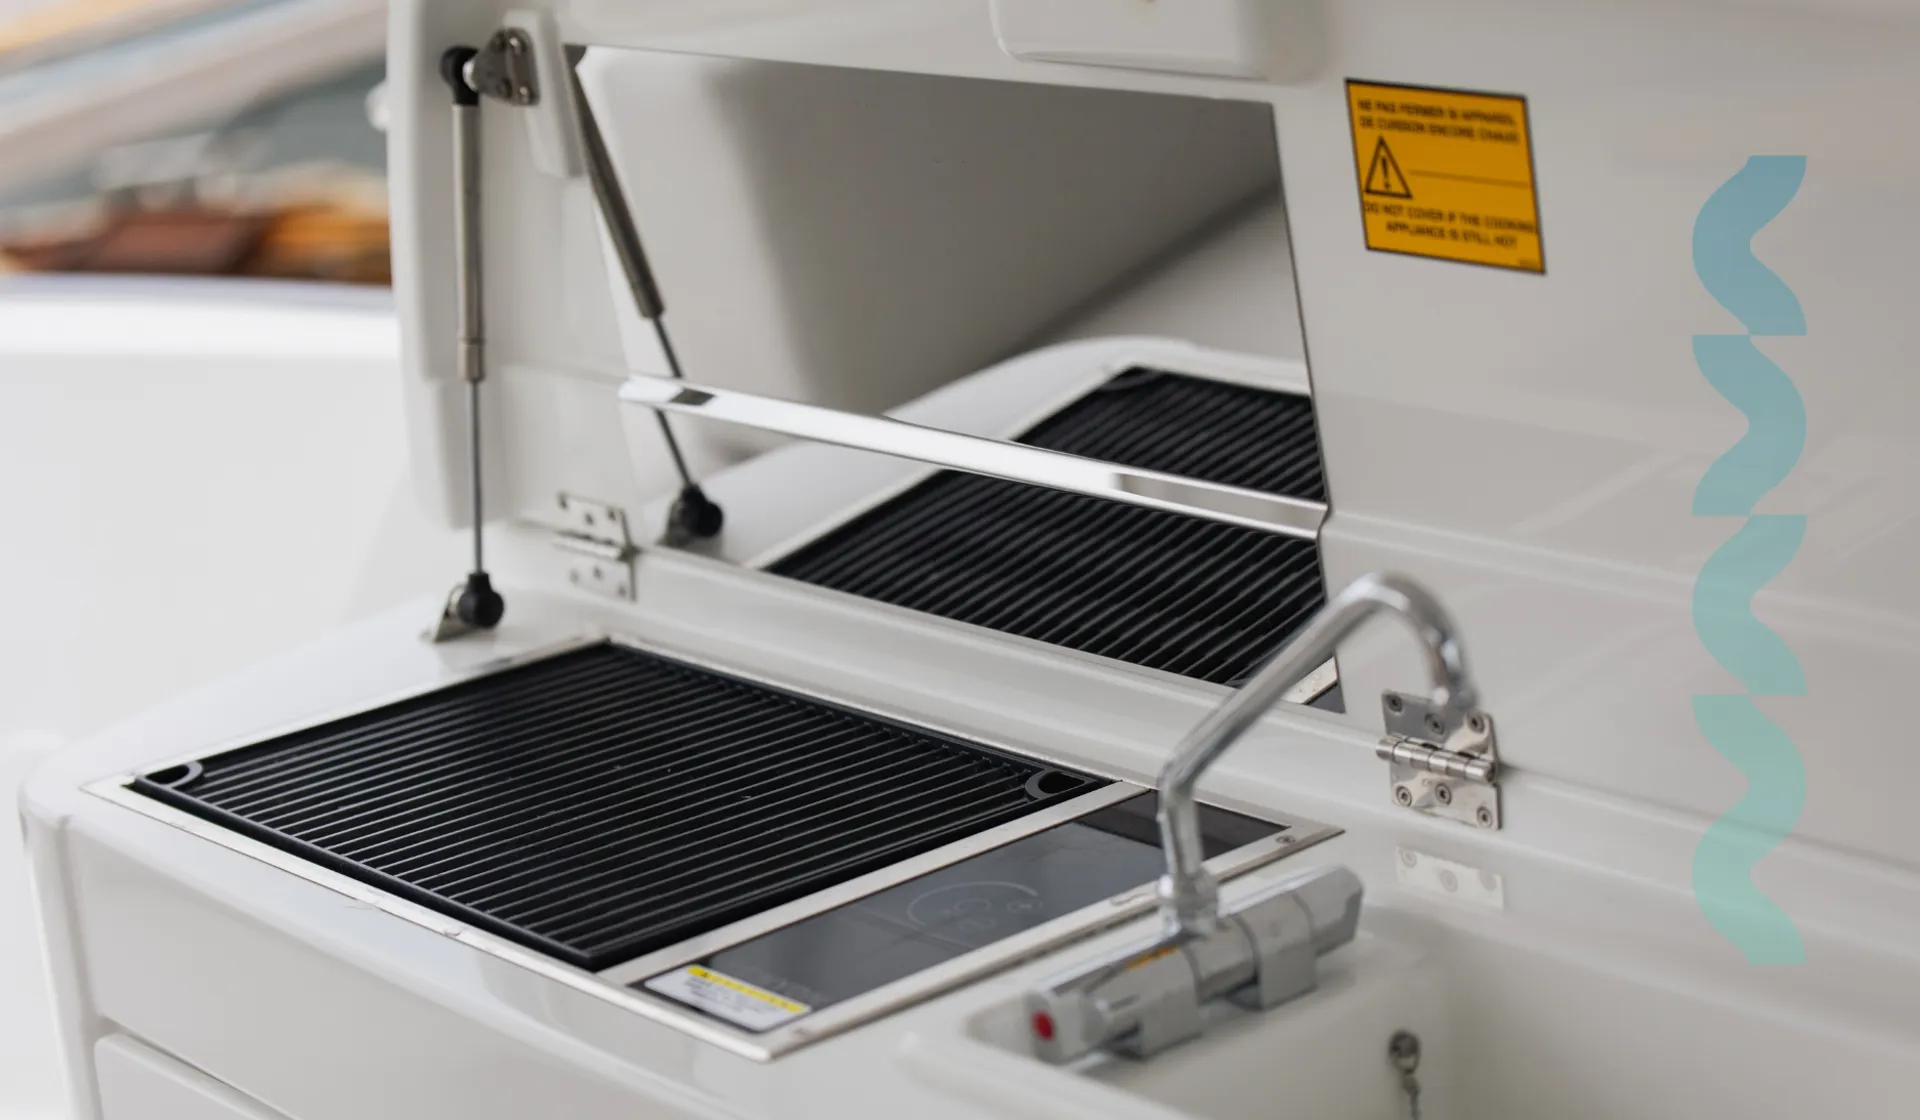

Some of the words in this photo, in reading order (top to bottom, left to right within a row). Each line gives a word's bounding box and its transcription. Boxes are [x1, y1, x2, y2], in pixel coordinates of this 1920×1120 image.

[1358, 100, 1373, 111] NE
[1377, 102, 1396, 113] PAS
[1401, 104, 1444, 117] FERMER
[1359, 116, 1374, 128] DE
[1379, 117, 1425, 132] CUISSON
[1429, 123, 1475, 138] ENCORE
[1383, 203, 1404, 216] NOT
[1408, 206, 1444, 221] COVER
[1460, 211, 1480, 225] THE
[1386, 220, 1445, 239] APPLIANCE
[1463, 231, 1491, 246] STILL
